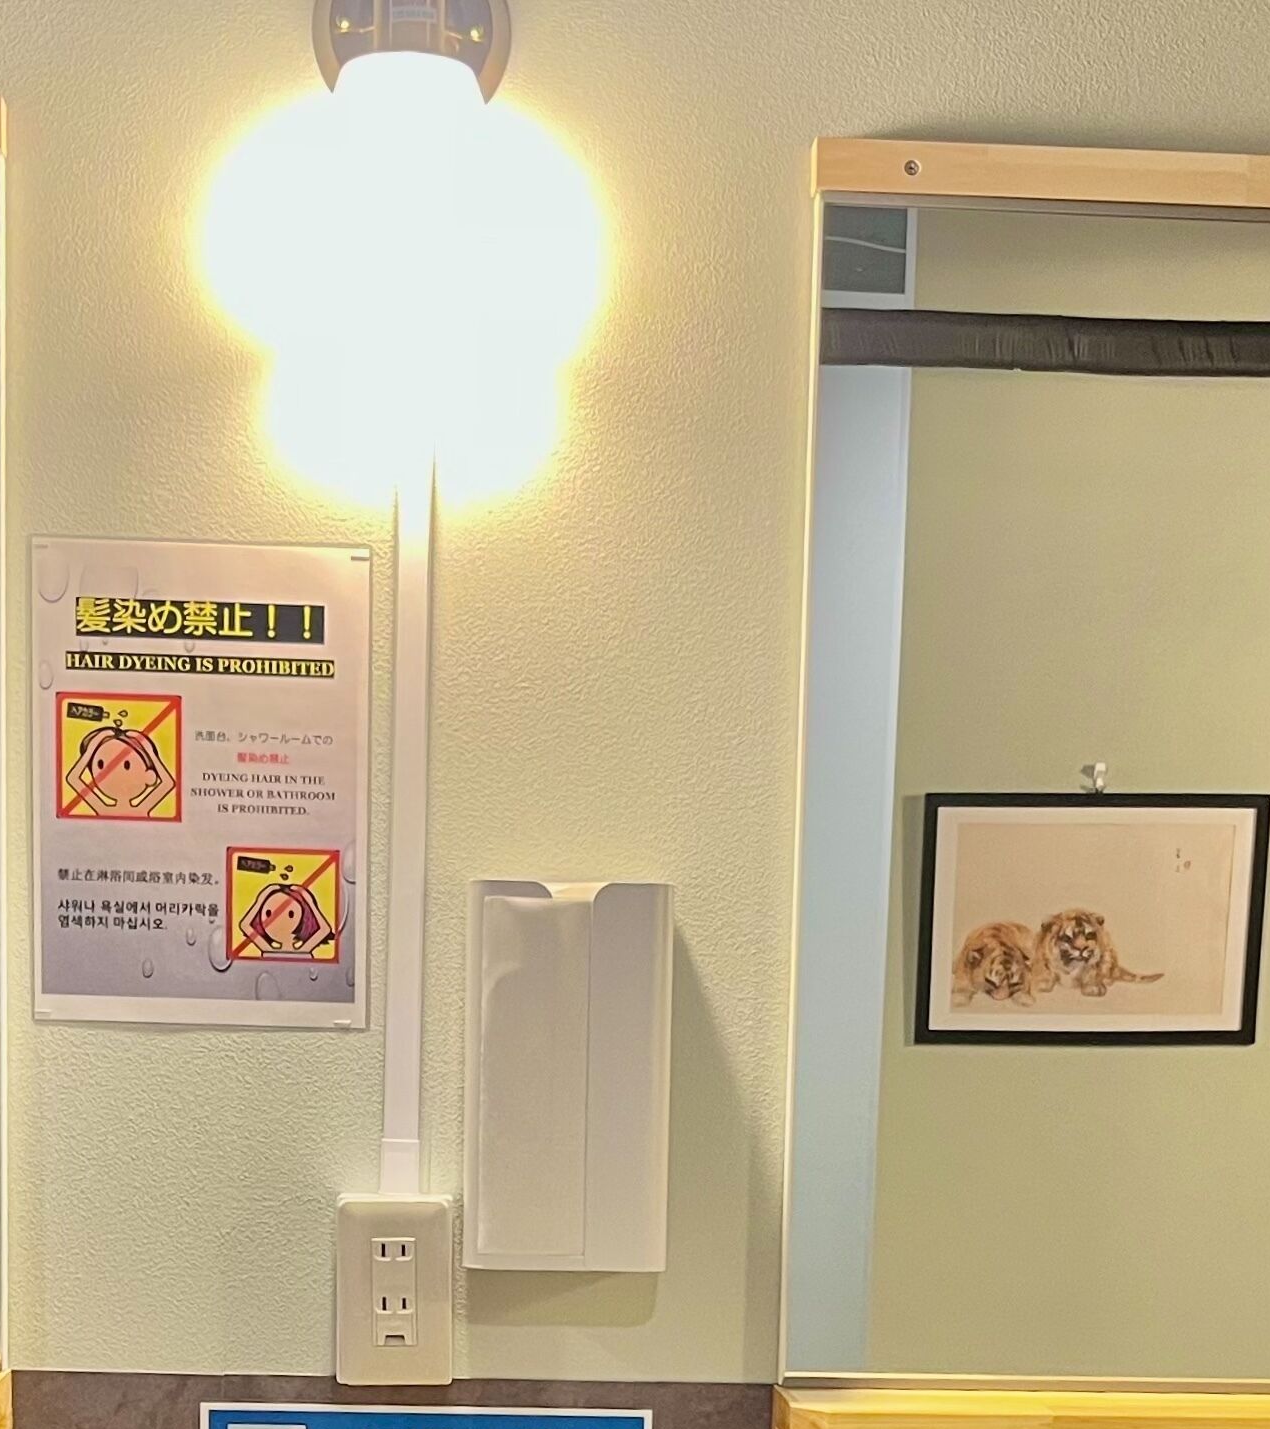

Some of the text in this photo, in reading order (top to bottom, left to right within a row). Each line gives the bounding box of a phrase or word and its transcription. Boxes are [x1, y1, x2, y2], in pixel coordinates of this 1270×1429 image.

[76, 597, 313, 640] 髪染め禁止！！
[66, 653, 335, 677] HAIR DYEING IS PROHIBITED
[202, 772, 325, 785] DYEING HAIR IN THE
[190, 787, 335, 801] SHOWER OR BATHROOM
[217, 803, 310, 816] IS PROHIBITED.
[58, 899, 219, 917] 샤워나 욕실에서 머리카락을
